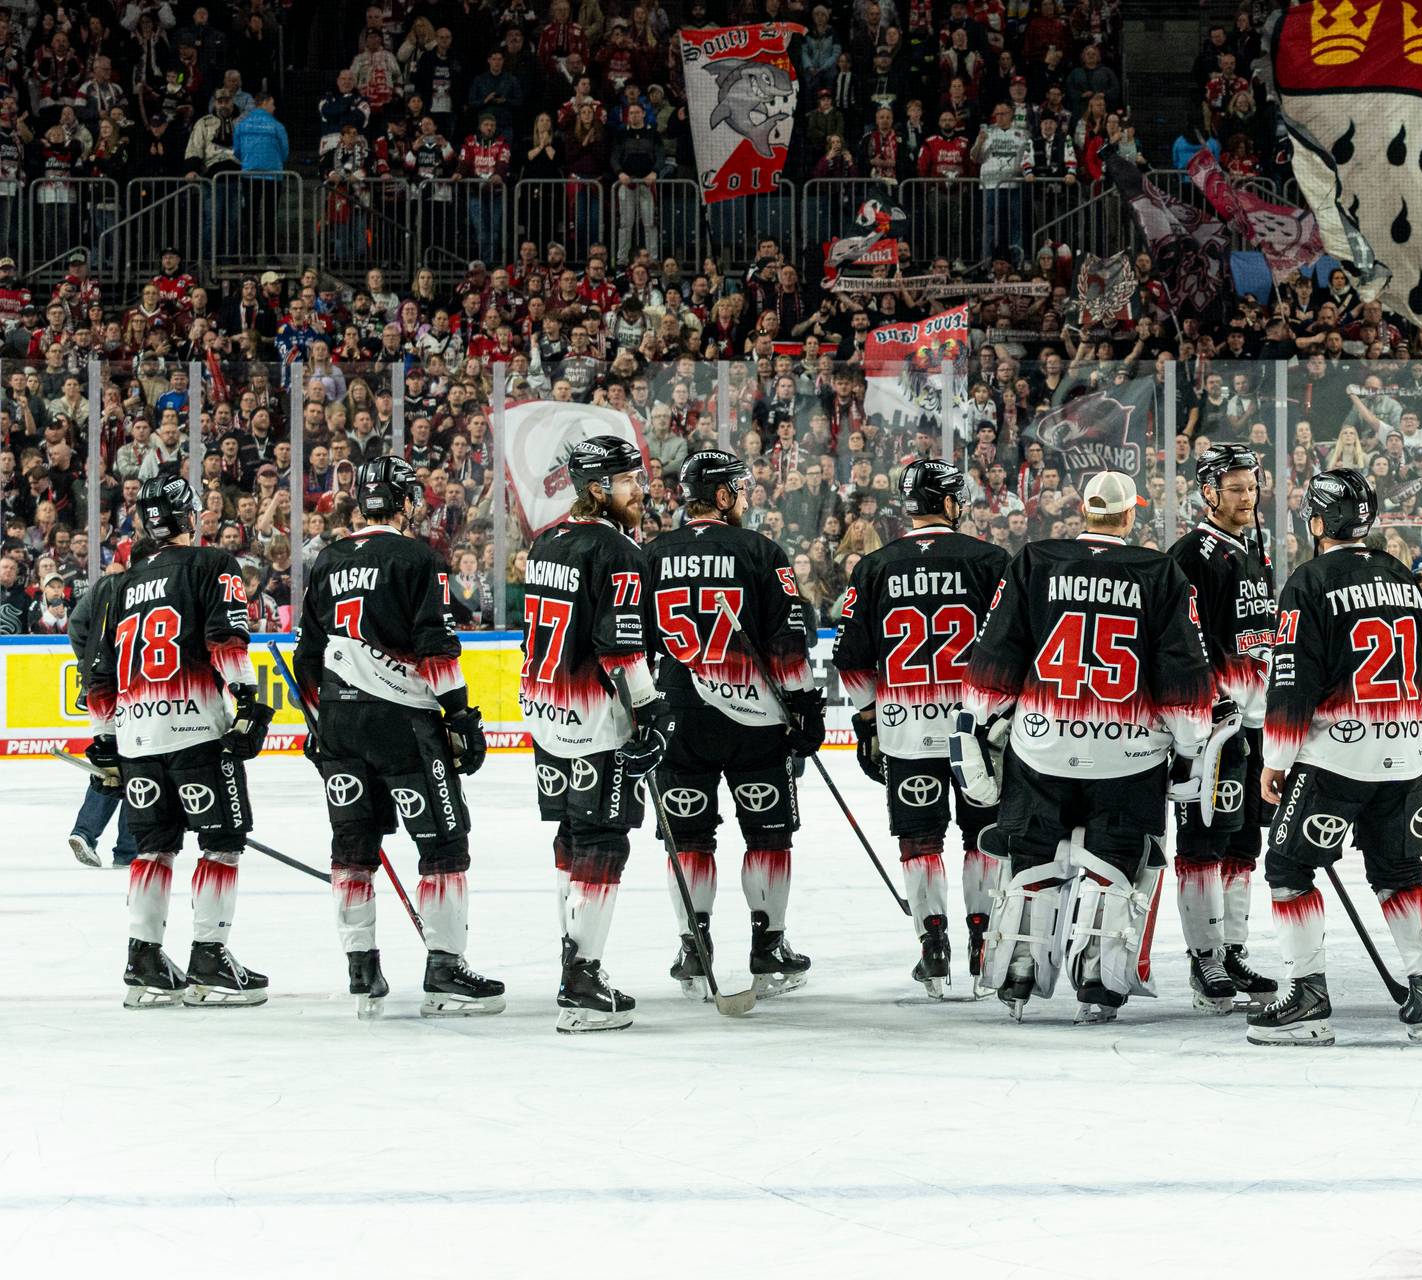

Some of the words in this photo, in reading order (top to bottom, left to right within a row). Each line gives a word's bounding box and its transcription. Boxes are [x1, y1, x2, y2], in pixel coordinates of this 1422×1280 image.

[578, 442, 610, 457] STETSON
[693, 452, 729, 461] STETSON
[1314, 480, 1346, 496] STETSON
[147, 507, 159, 517] 78
[1359, 502, 1369, 514] 21
[329, 568, 379, 597] KASKI
[660, 555, 735, 581] AUSTIN
[888, 567, 967, 598] GLÖTZL
[125, 578, 168, 610] BOKK
[218, 573, 247, 603] 78
[611, 572, 642, 607] 77
[1048, 575, 1142, 609] ANCICKA
[334, 597, 367, 641] 7
[654, 587, 744, 665] 57
[1275, 609, 1300, 646] 21
[115, 605, 182, 694] 78
[520, 594, 574, 683] 77
[883, 604, 977, 688] 22
[1034, 611, 1140, 703] 45
[1350, 616, 1418, 703] 21
[129, 699, 200, 721] TOYOTA
[1055, 719, 1150, 741] TOYOTA
[226, 778, 243, 829] TOYOTA
[437, 780, 457, 832] TOYOTA
[609, 767, 624, 820] TOYOTA
[1284, 773, 1307, 822] TOYOTA
